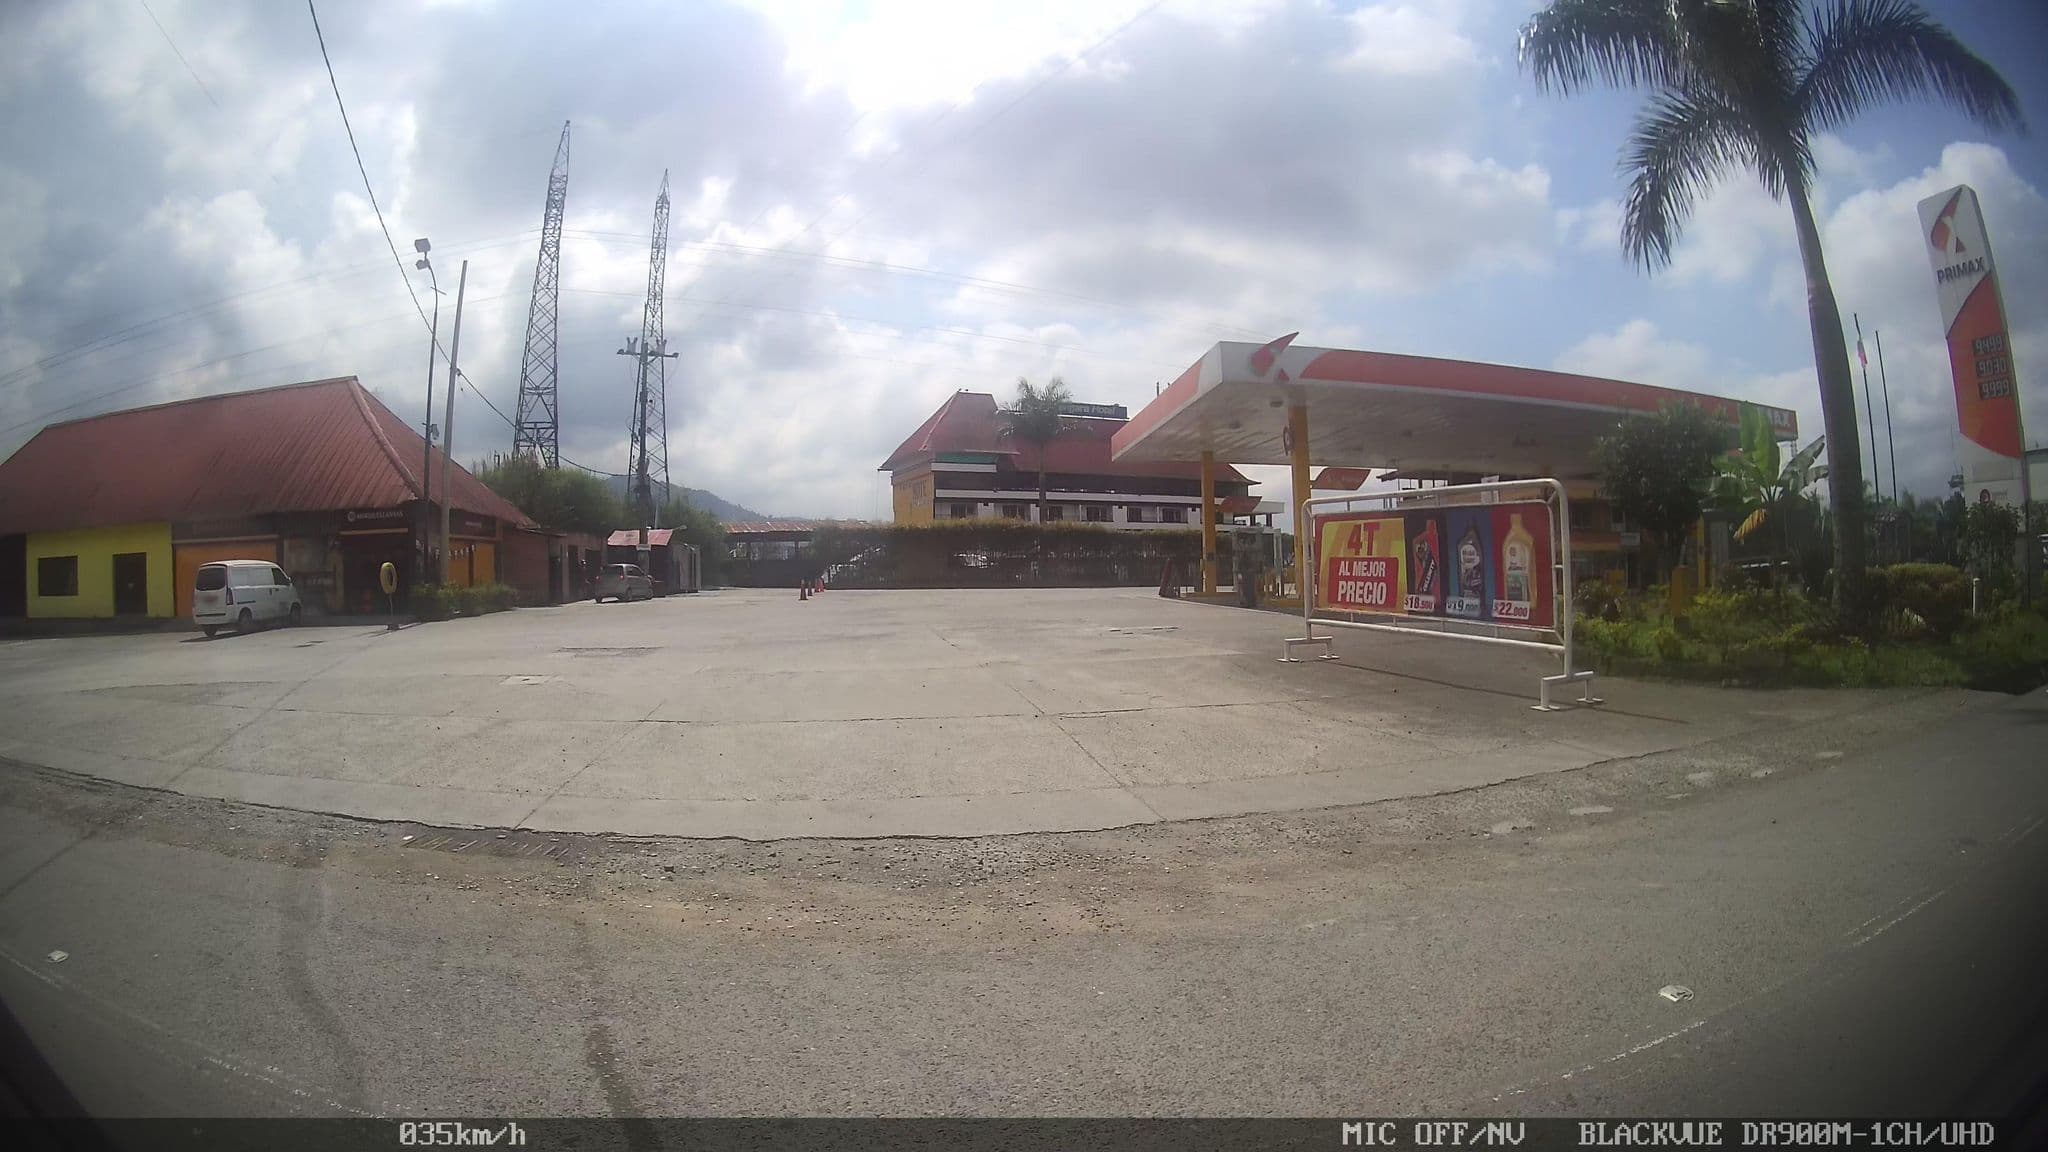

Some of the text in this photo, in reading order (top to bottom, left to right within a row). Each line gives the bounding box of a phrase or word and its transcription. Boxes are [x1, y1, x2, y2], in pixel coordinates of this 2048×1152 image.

[1936, 256, 1986, 285] PRIMAX
[1347, 522, 1380, 556] 4T
[1338, 560, 1387, 578] AL MEJOR
[1337, 580, 1388, 605] PRECIO
[1494, 602, 1528, 617] $22.000
